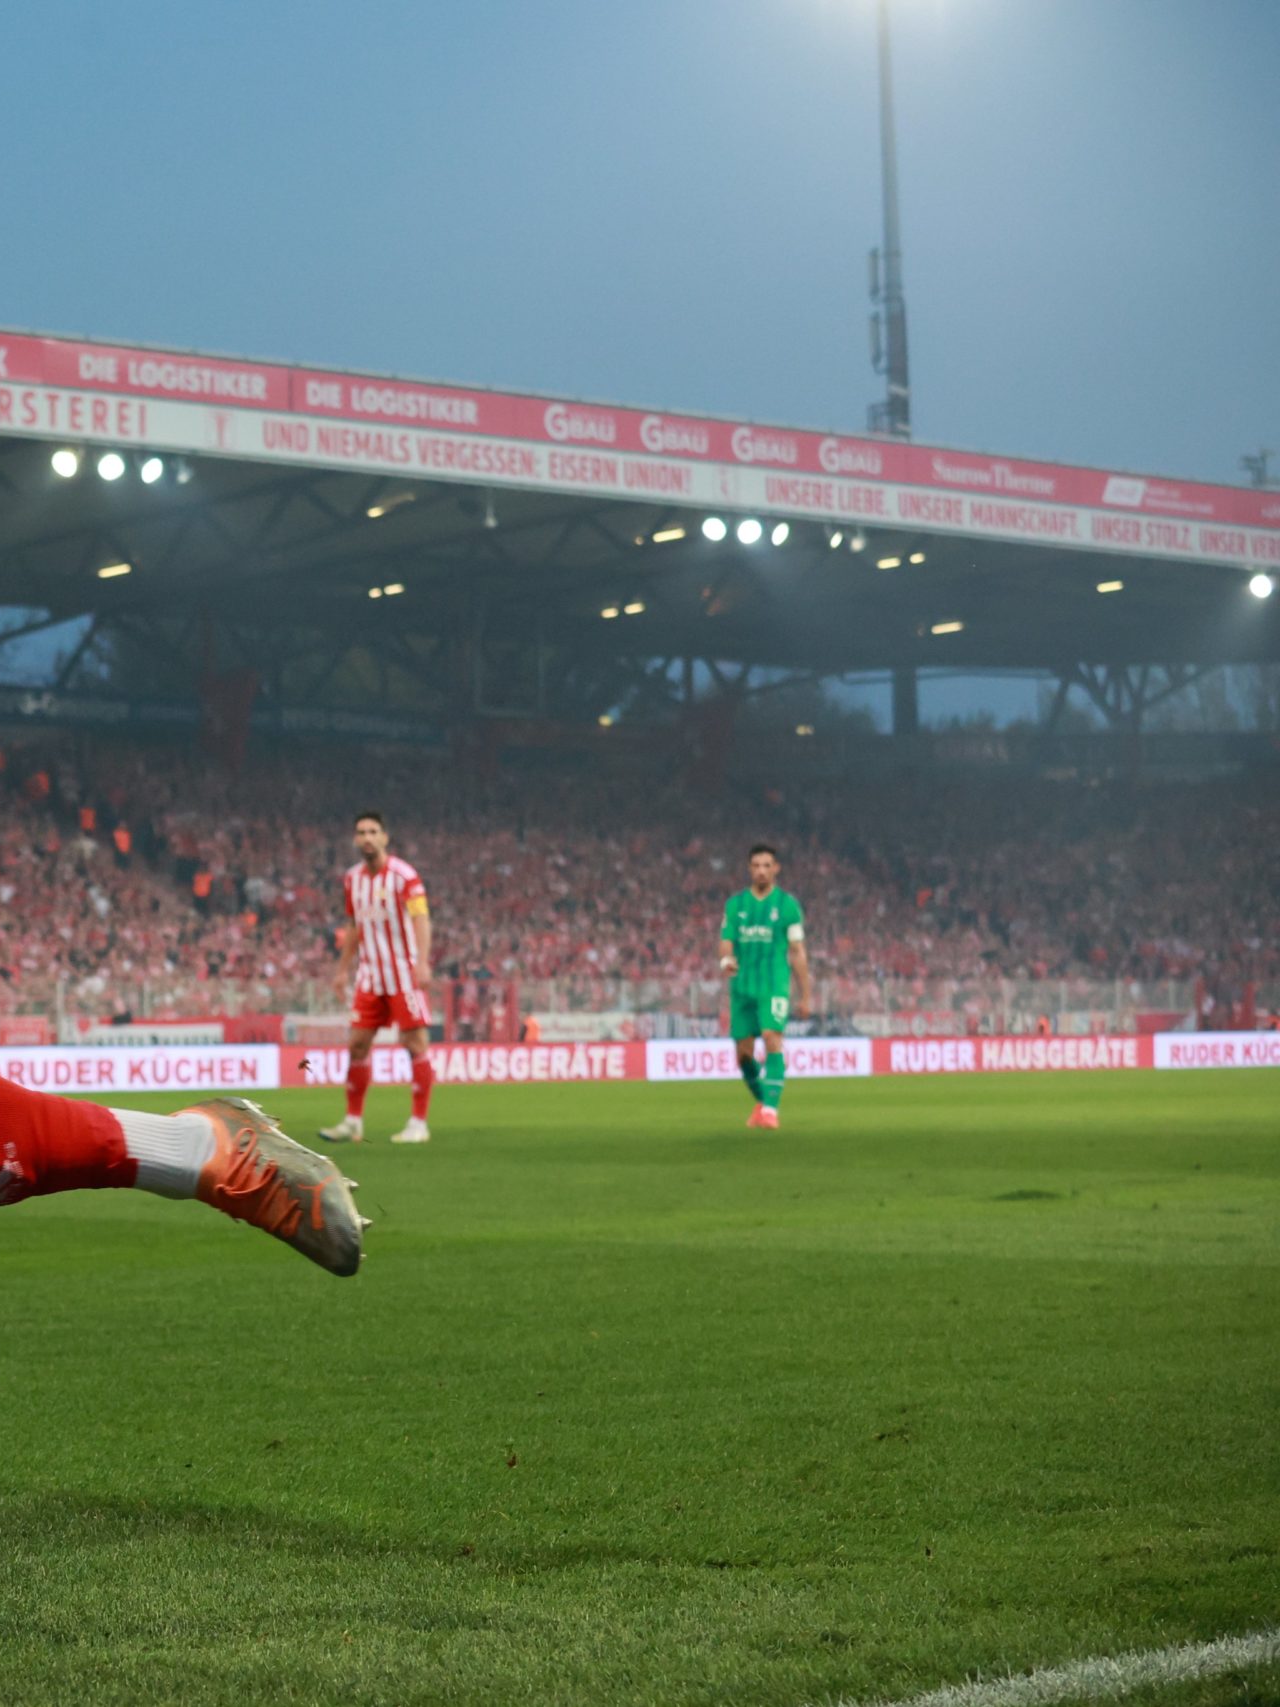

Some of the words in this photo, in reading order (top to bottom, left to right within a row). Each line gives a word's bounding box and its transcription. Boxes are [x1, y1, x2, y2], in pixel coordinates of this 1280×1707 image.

[79, 353, 117, 384] DIE
[128, 360, 268, 400] LOGISTIKER
[306, 379, 342, 409] DIE
[350, 386, 479, 425] LOGISTIKER
[263, 419, 310, 451] UND
[317, 425, 411, 465] NIEMALS
[548, 451, 617, 486] EISERN
[766, 476, 834, 511] UNSERE
[7, 1059, 115, 1087] RUDER
[128, 1051, 258, 1085] KÜCHEN
[891, 1040, 976, 1073] RUDER
[982, 1035, 1138, 1070] HAUSGERÄTE
[1171, 1043, 1235, 1067] RUDER
